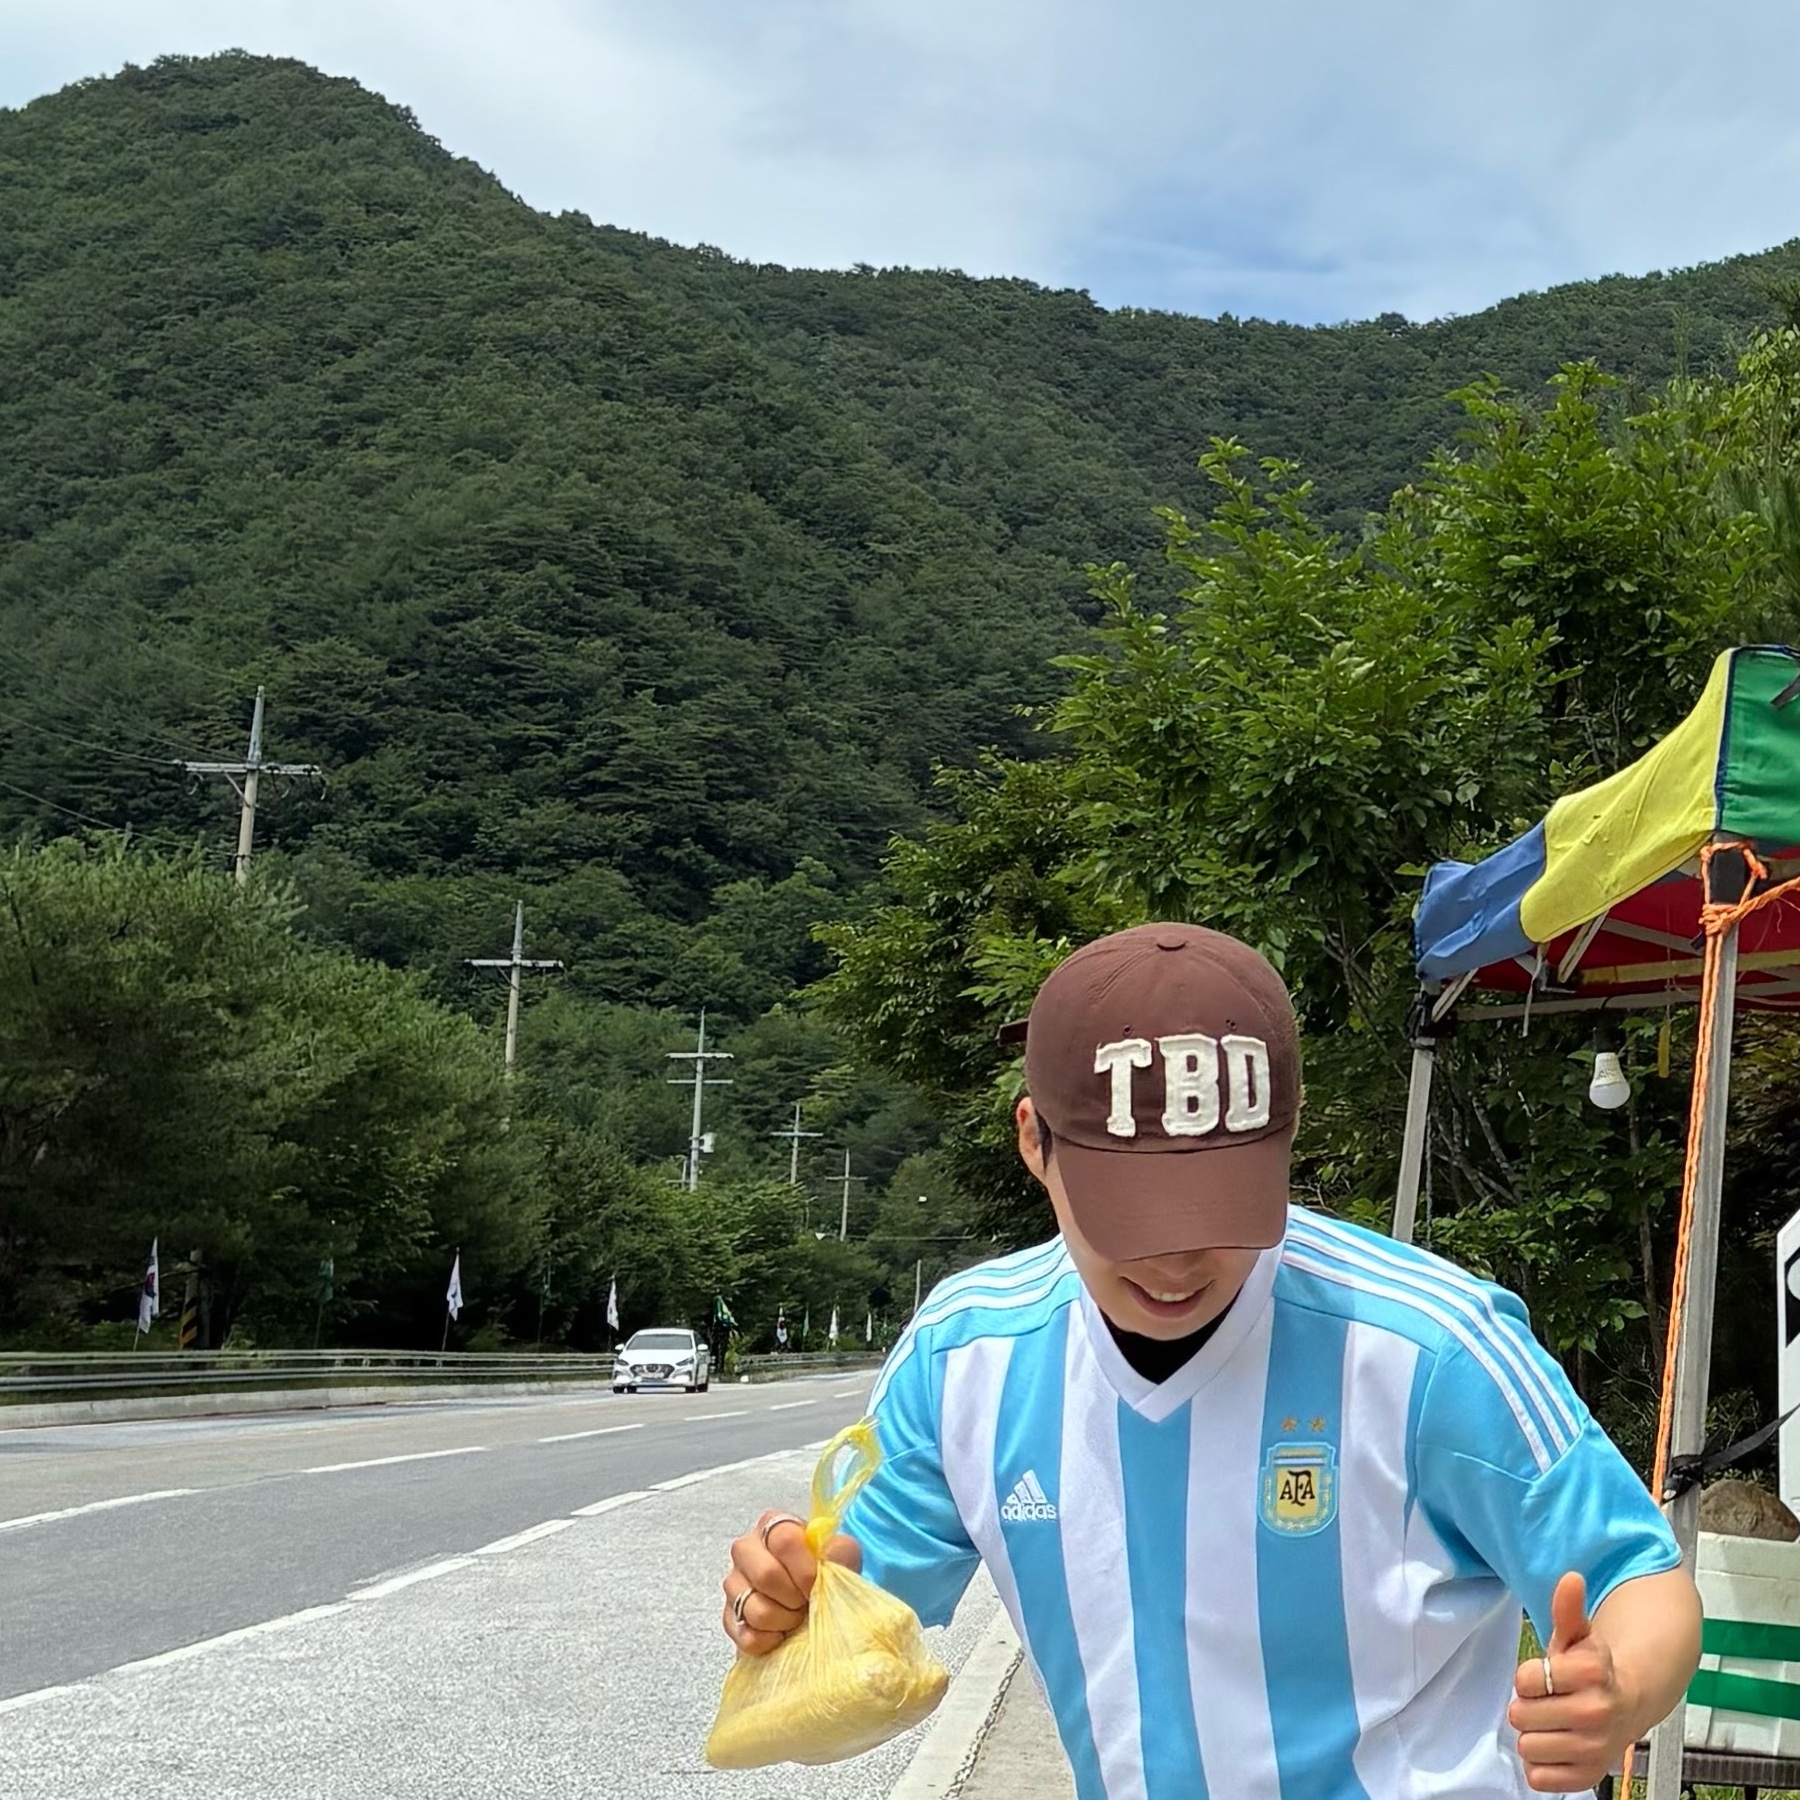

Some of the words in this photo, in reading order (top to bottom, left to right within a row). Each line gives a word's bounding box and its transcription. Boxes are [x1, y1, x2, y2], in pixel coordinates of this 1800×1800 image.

[1093, 1033, 1271, 1138] TBD
[1279, 1469, 1316, 1507] AFA
[1001, 1502, 1057, 1521] adidas
